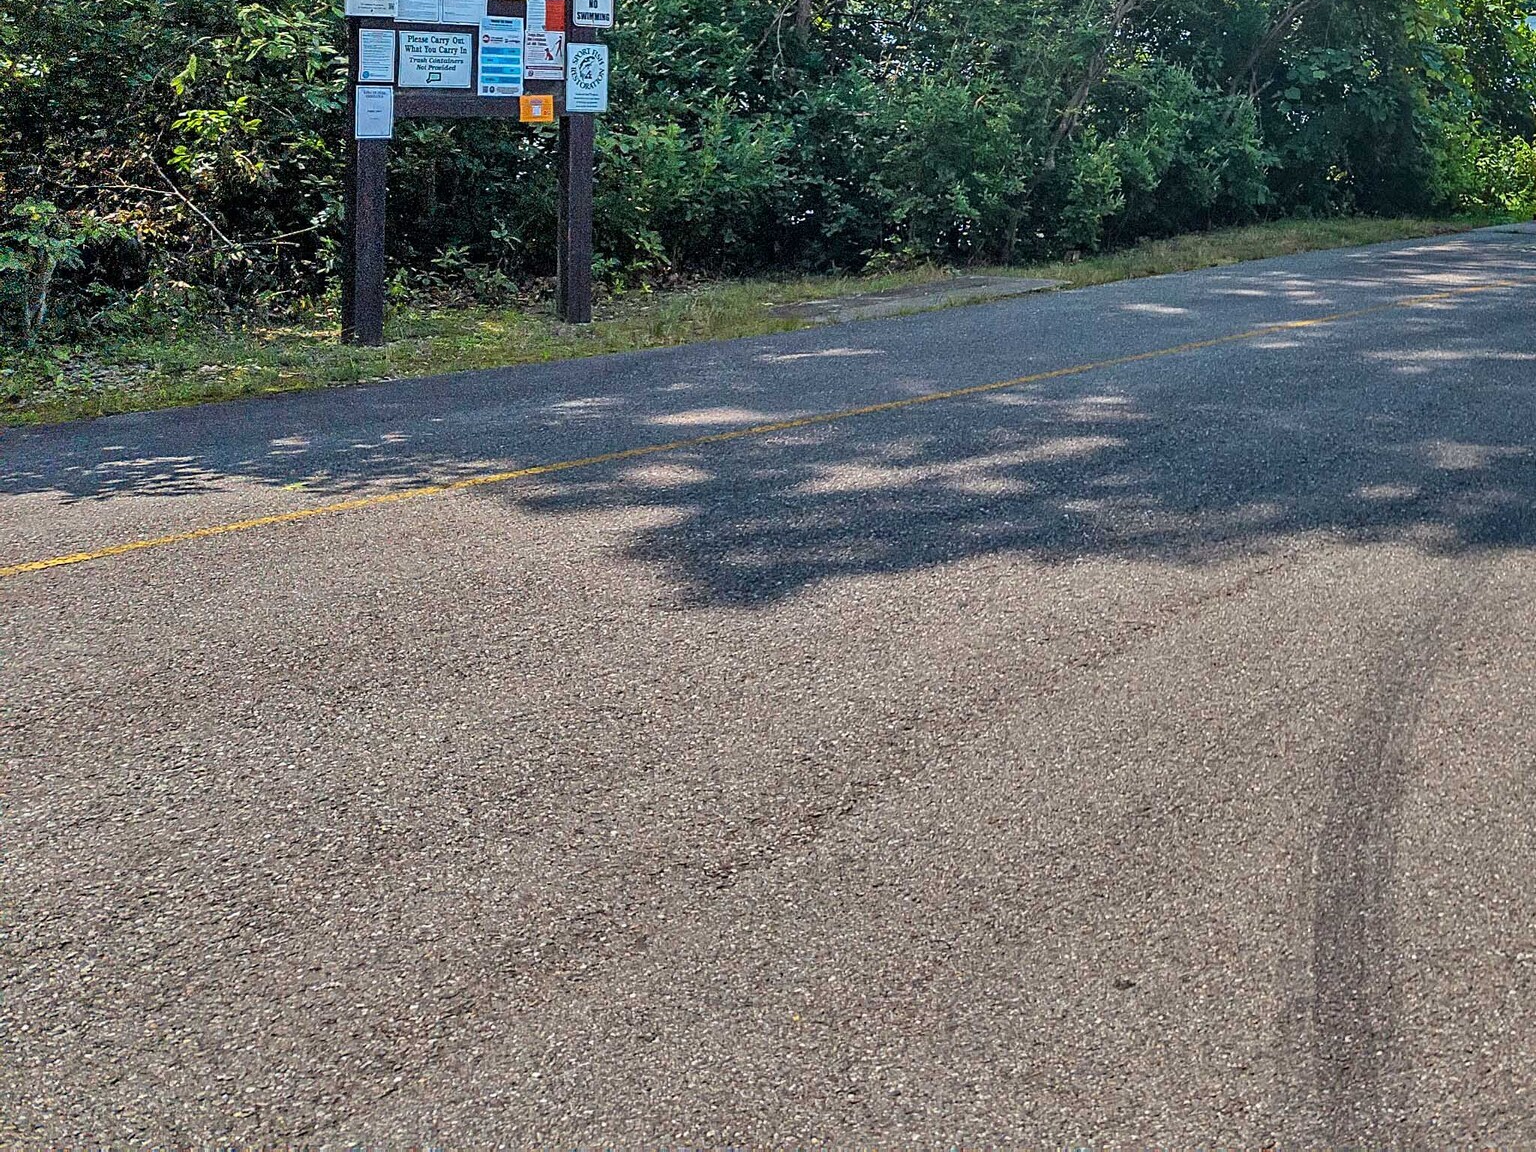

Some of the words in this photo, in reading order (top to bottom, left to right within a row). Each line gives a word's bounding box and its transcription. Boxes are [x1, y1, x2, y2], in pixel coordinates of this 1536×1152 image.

[588, 0, 598, 9] NO
[577, 11, 610, 22] SWIMMING
[407, 35, 428, 43] Please
[430, 36, 450, 45] Carry
[405, 44, 422, 52] What
[438, 46, 458, 55] Carry
[572, 48, 591, 65] SPORT
[592, 49, 605, 65] FISH
[571, 67, 605, 89] RESTORATION
